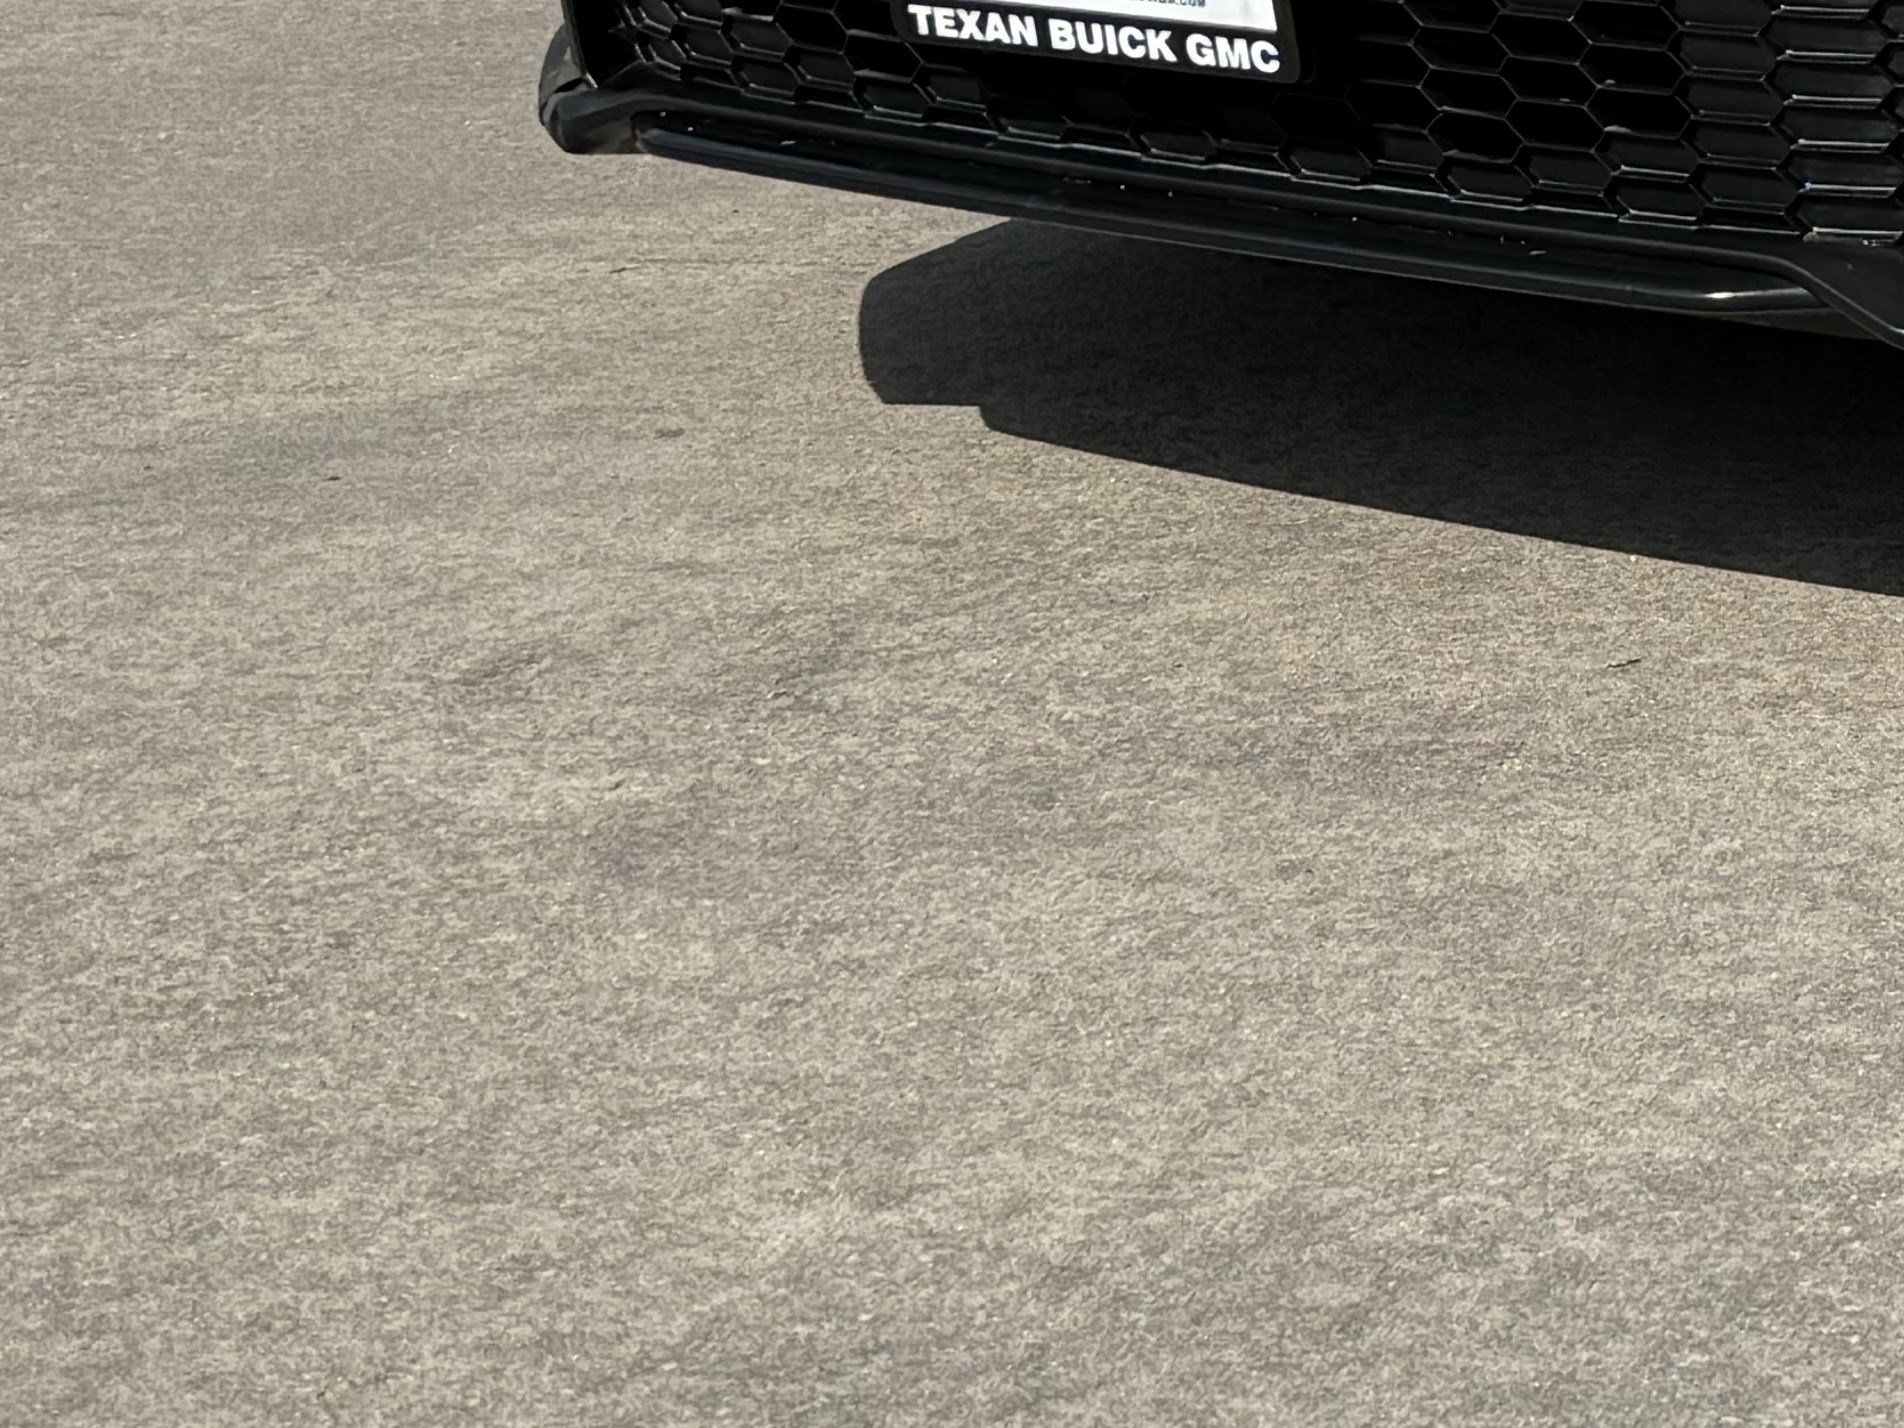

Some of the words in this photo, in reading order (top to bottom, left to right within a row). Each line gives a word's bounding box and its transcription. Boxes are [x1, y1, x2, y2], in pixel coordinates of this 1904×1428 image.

[908, 4, 1039, 48] TEXAN
[1048, 18, 1180, 63] BUICK
[1186, 37, 1282, 75] GMC
